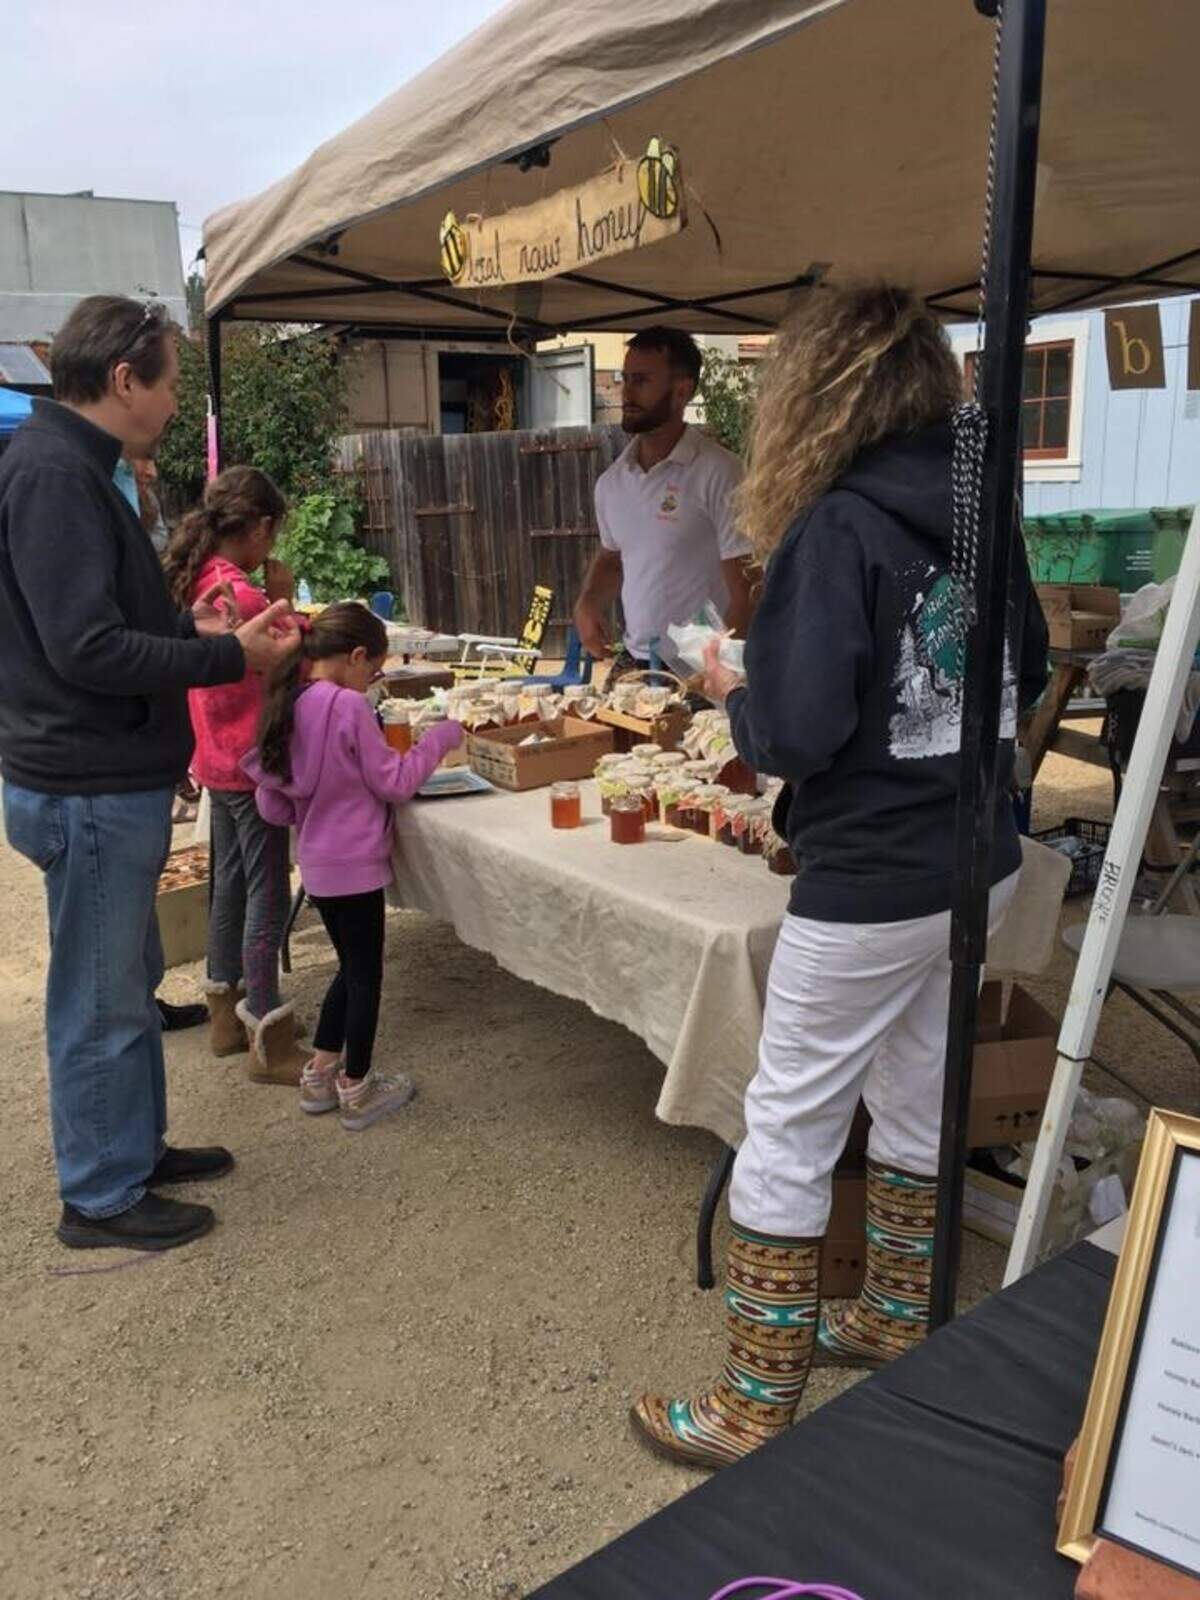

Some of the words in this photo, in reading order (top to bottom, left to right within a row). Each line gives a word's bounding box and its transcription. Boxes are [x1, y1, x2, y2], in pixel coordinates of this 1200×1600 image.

[519, 236, 561, 275] raw
[576, 197, 647, 260] honey
[1113, 320, 1150, 375] b
